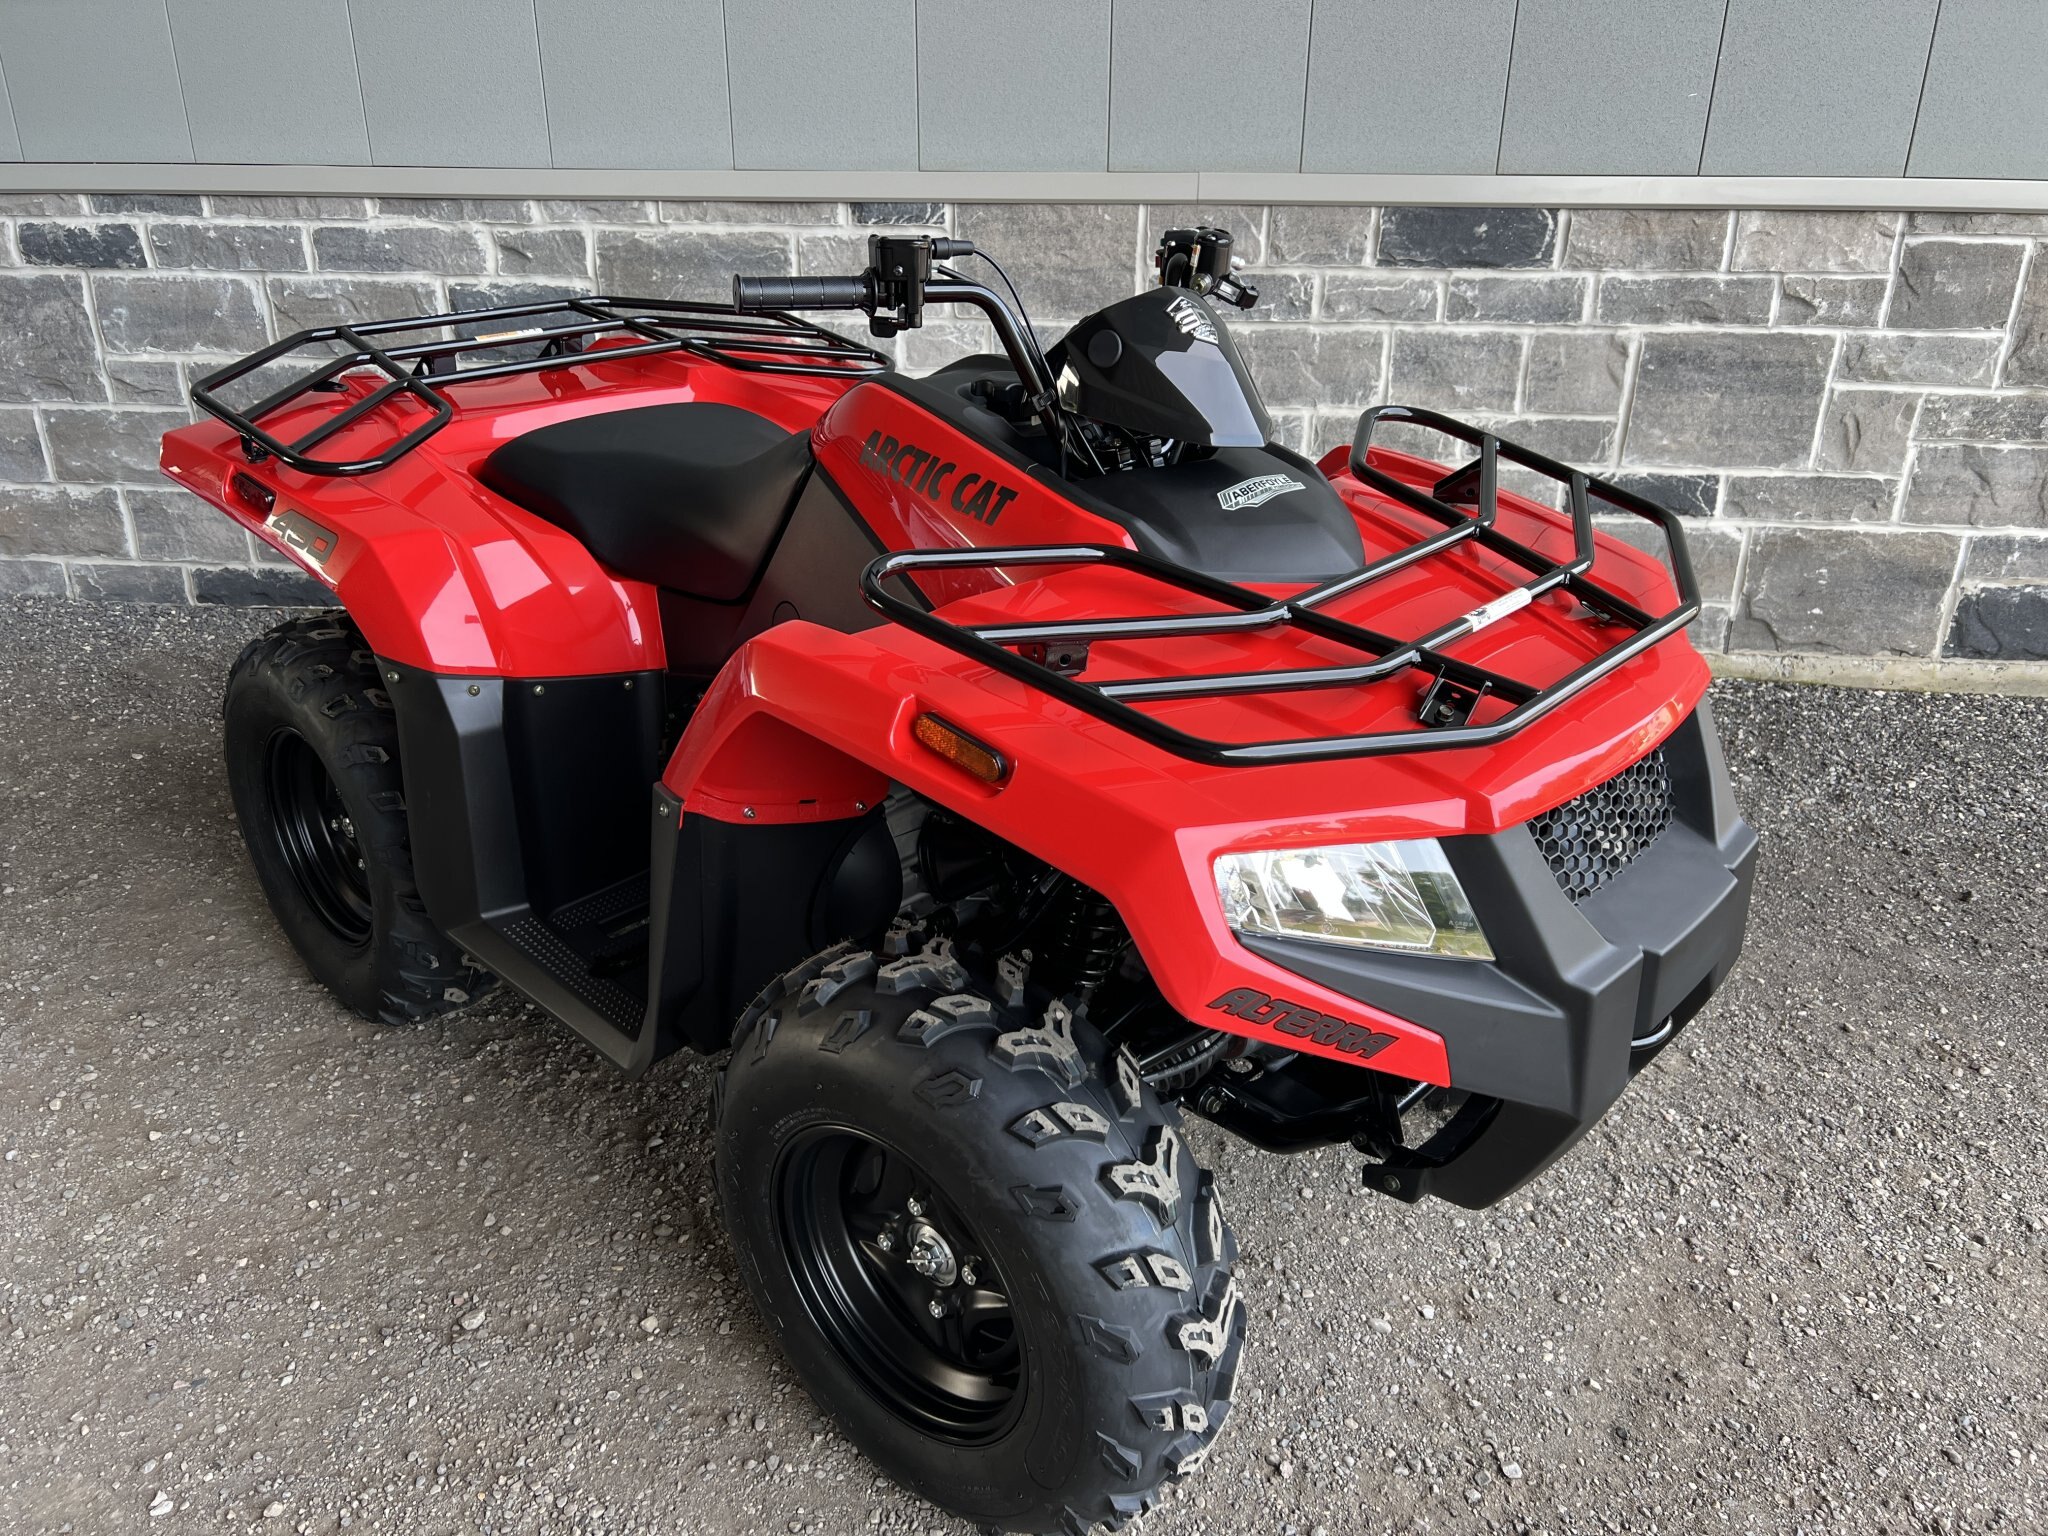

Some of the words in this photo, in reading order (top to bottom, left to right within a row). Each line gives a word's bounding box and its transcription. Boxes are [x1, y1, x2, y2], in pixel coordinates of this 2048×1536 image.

[859, 429, 957, 502] ARCTIC
[951, 473, 1019, 526] CAT
[1232, 477, 1292, 500] ABERFOYLE
[271, 509, 339, 566] 450
[1206, 987, 1400, 1059] ALTERRA
